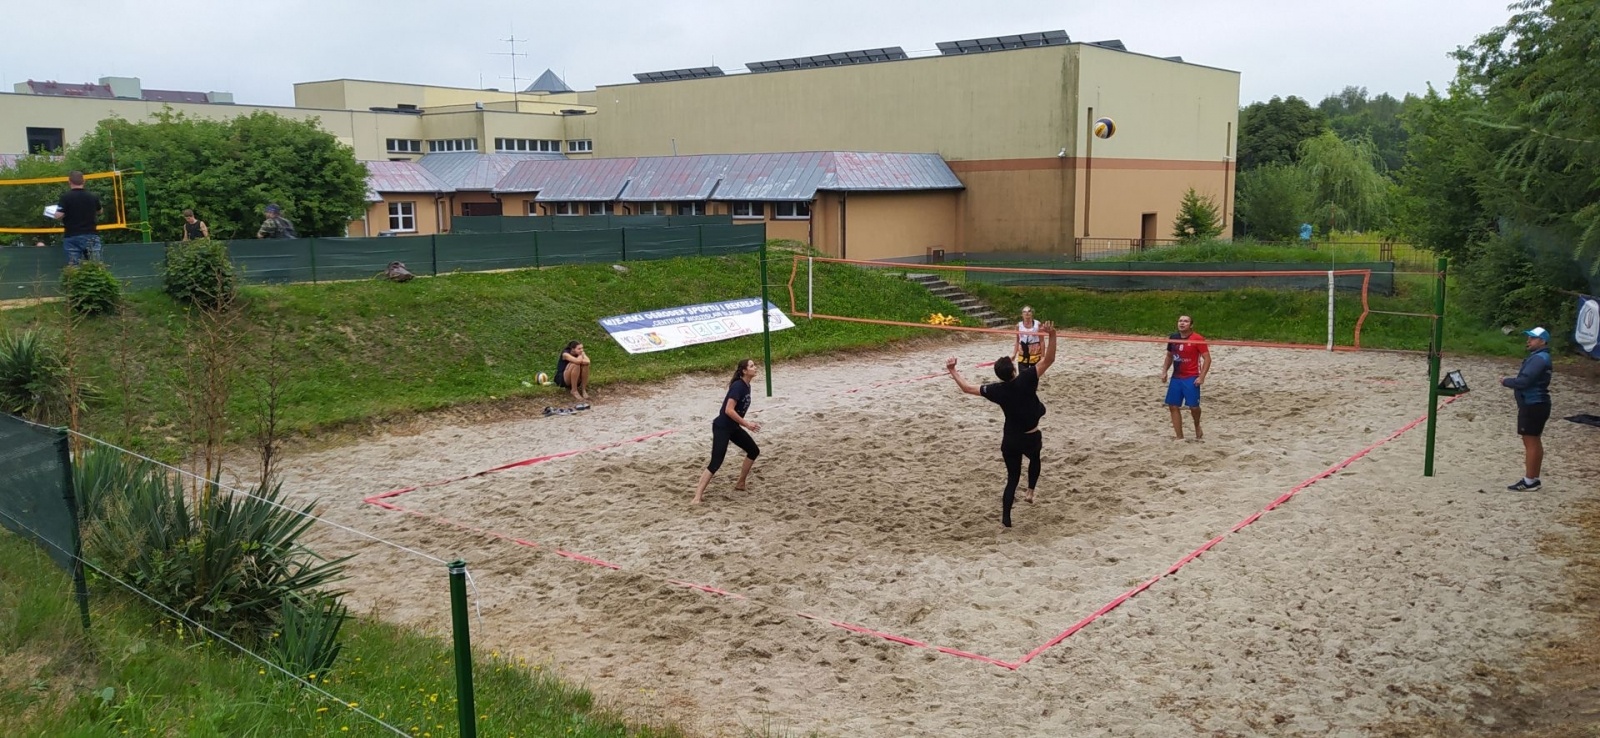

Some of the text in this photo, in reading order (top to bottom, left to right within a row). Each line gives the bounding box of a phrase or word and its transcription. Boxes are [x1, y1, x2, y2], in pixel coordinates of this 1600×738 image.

[602, 314, 645, 325] MIEJSKI
[644, 309, 687, 319] OŚRODEK
[686, 304, 720, 314] SPORTU
